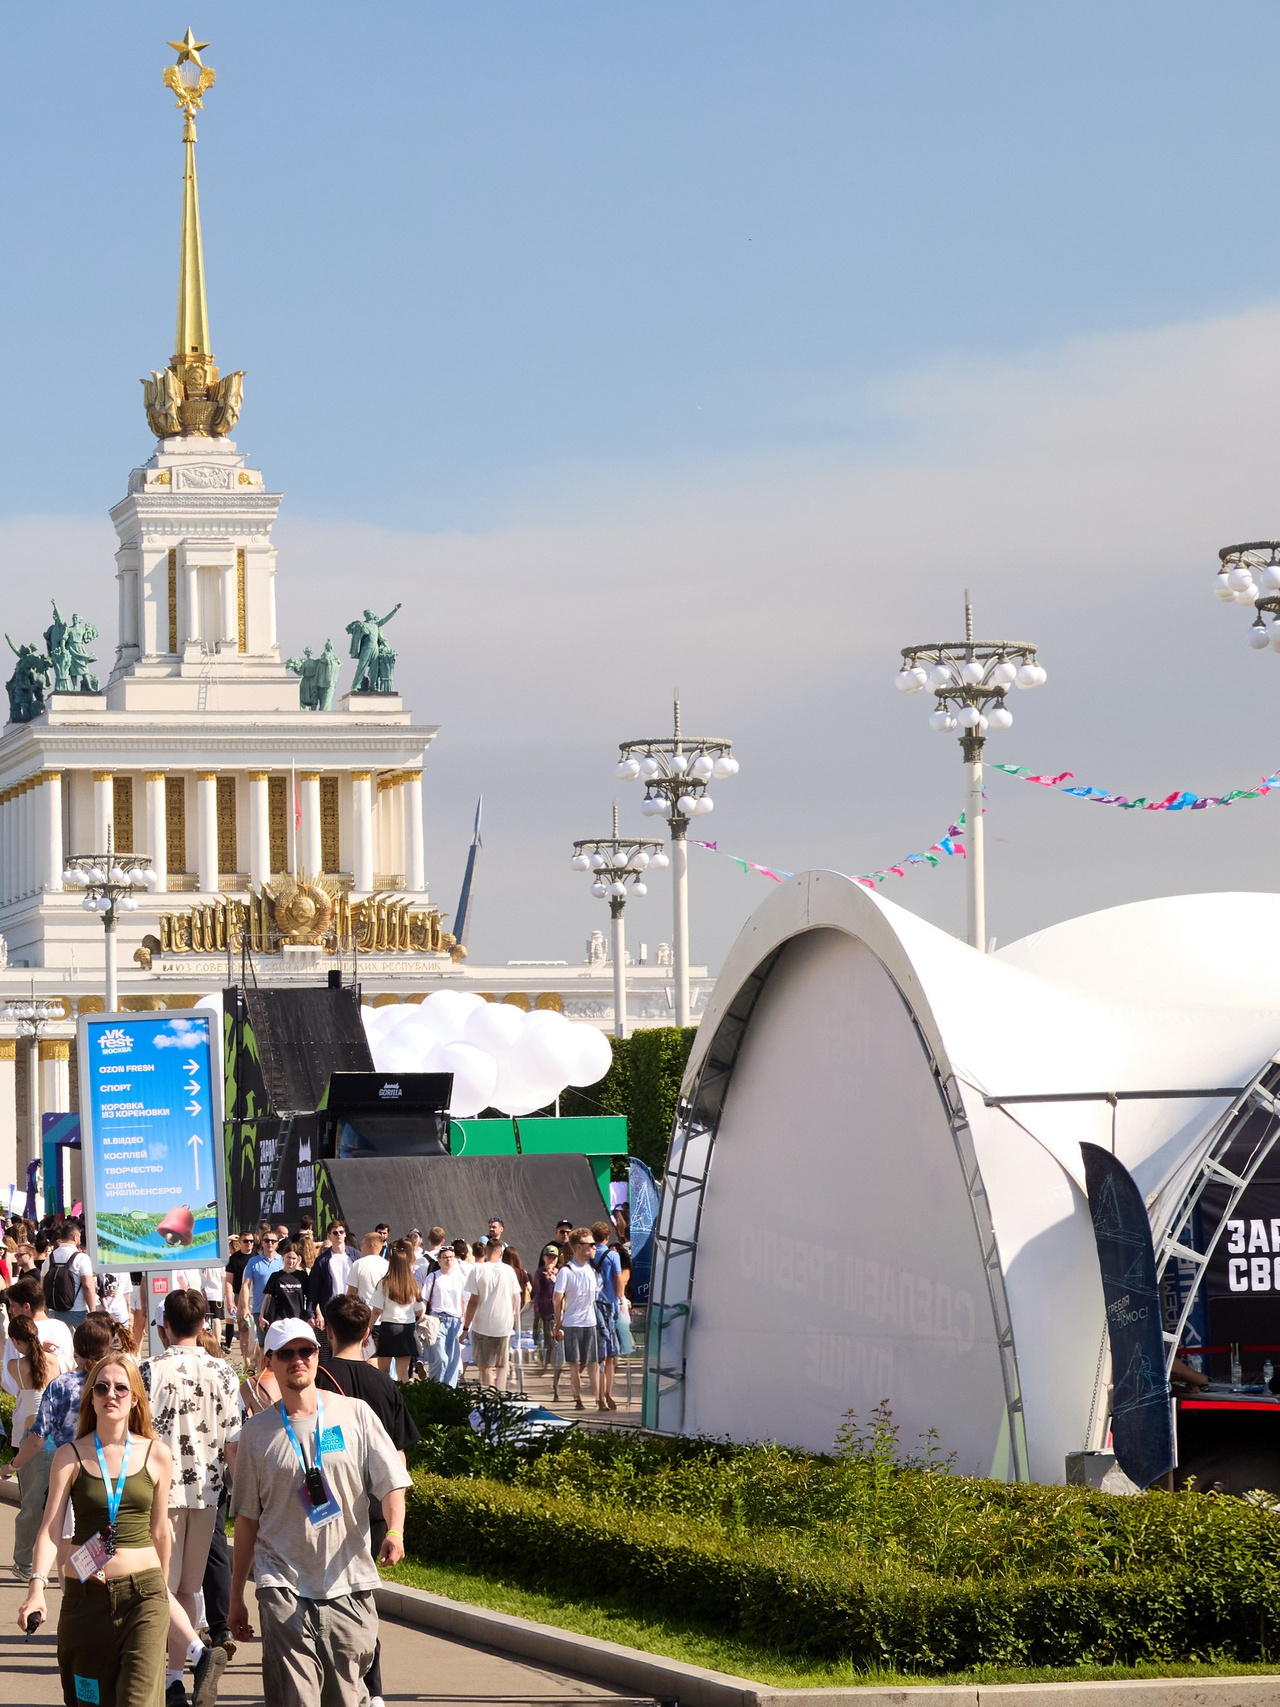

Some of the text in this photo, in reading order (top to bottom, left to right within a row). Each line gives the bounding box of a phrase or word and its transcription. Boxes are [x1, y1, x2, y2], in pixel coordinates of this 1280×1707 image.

[382, 961, 442, 971] РЕСПУБЛИК
[105, 1029, 125, 1038] VK
[97, 1035, 135, 1048] fest
[102, 1046, 132, 1055] МОСКВА
[99, 1064, 155, 1074] OZON FRESH
[100, 1084, 132, 1092] СПОРТ
[101, 1102, 144, 1111] КОРОВКА
[115, 1108, 170, 1118] КОРЕНОВКИ
[103, 1136, 144, 1145] М.ВИДЕО
[104, 1149, 147, 1160] КОСПЛЕЙ
[104, 1165, 164, 1175] ТВОРЧЕСТВО
[105, 1181, 137, 1190] СЦЕНА
[105, 1187, 182, 1197] ИНФЛЮЕНСЕРОВ
[1117, 1306, 1148, 1328] ОСМОС!
